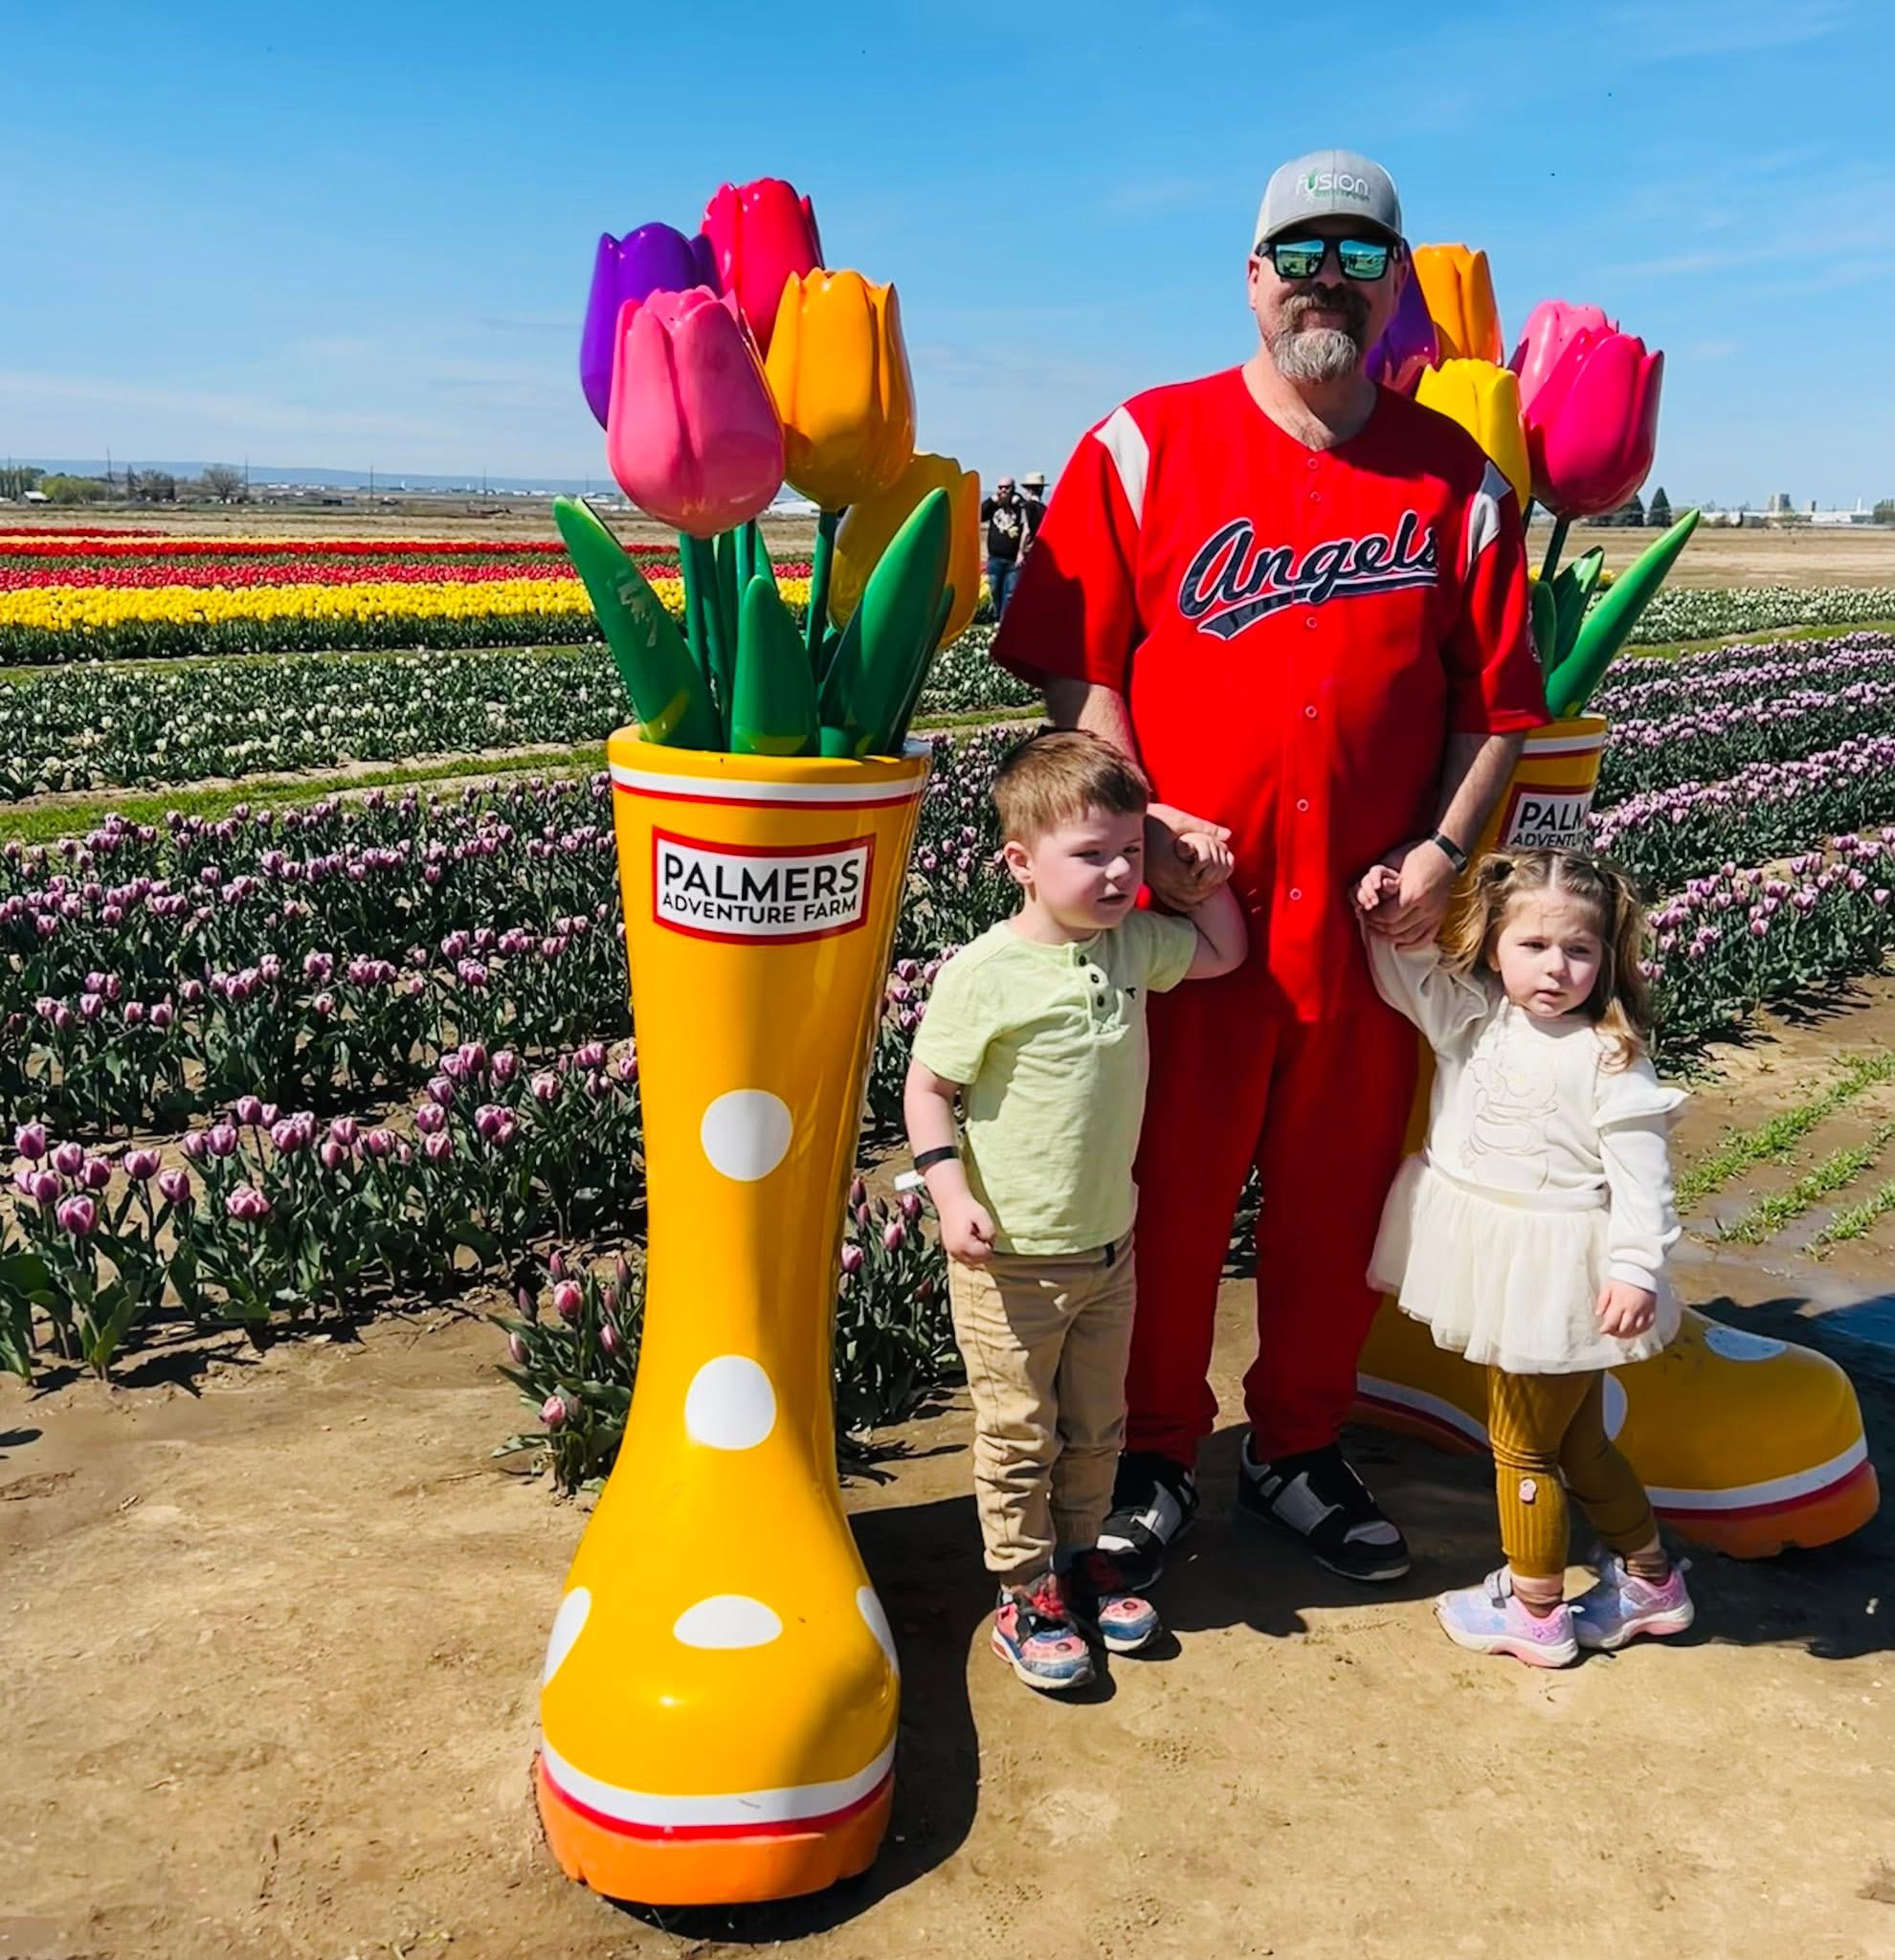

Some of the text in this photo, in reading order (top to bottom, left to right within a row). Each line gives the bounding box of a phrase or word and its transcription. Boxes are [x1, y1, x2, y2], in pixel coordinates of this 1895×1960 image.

[1178, 509, 1439, 619] Angels
[664, 853, 859, 902] PALMERS
[662, 892, 858, 924] ADVENTURE FARM
